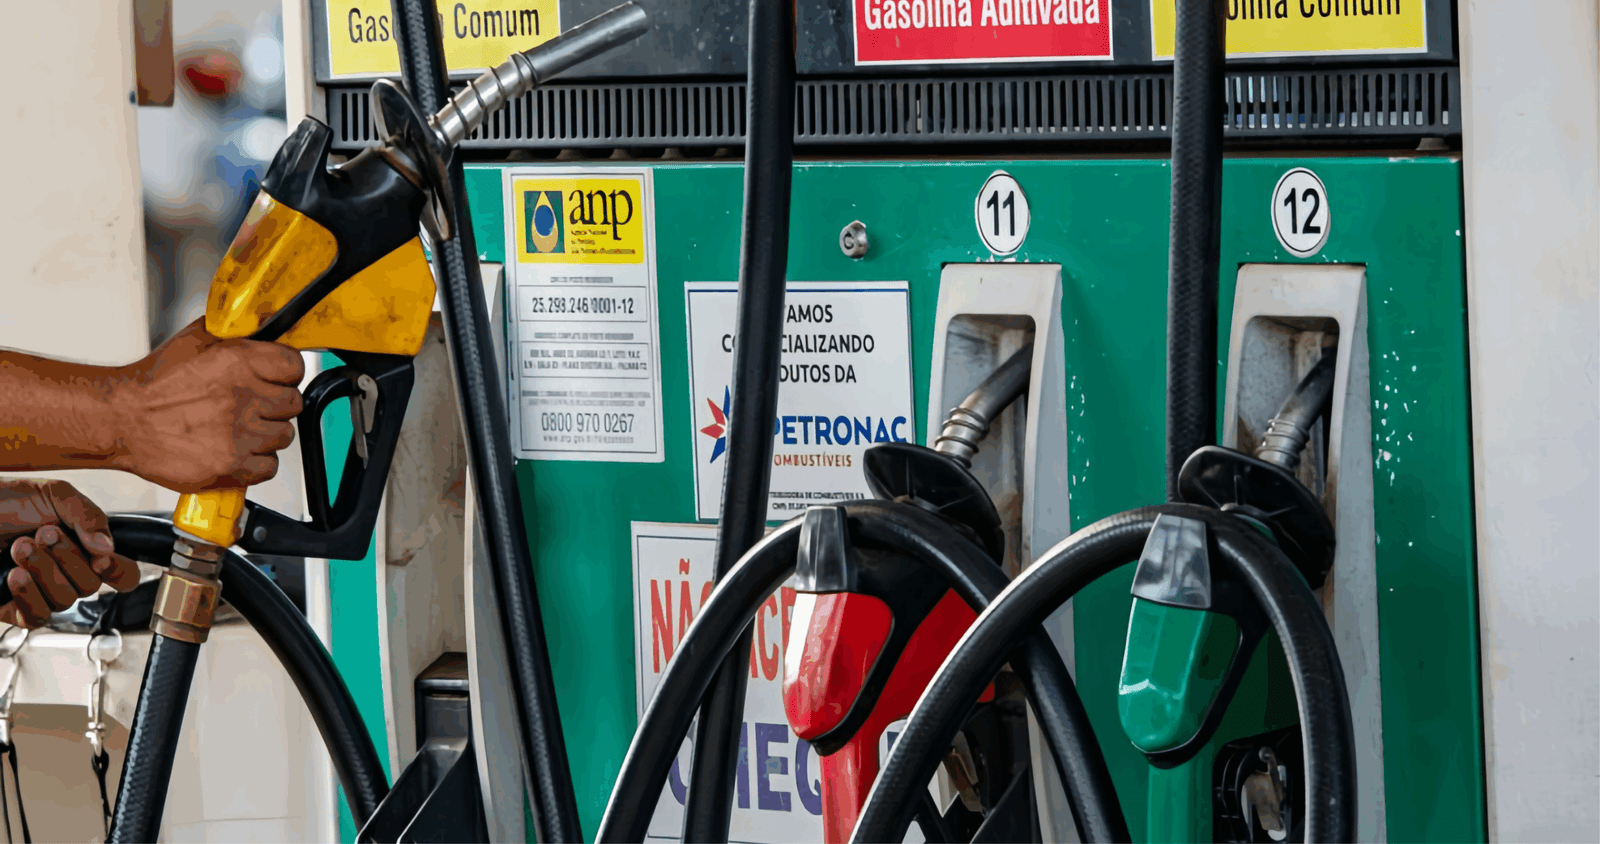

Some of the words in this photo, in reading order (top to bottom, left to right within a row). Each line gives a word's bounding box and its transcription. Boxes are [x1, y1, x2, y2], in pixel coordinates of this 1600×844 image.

[453, 2, 540, 39] Comum
[864, 0, 973, 30] Gasolina
[980, 0, 1101, 27] Aditivada
[568, 189, 633, 241] anp
[986, 190, 1015, 236] 11
[1283, 187, 1321, 234] 12
[785, 304, 833, 323] AMOS
[721, 334, 875, 354] CCIALIZANDO
[779, 364, 831, 383] DUTOS
[834, 364, 857, 383] DA
[541, 412, 572, 432] 0800
[576, 412, 600, 433] 970
[603, 413, 635, 433] 0267
[773, 451, 852, 467] OMBUSTÍVEIS
[650, 557, 714, 673] NÃ
